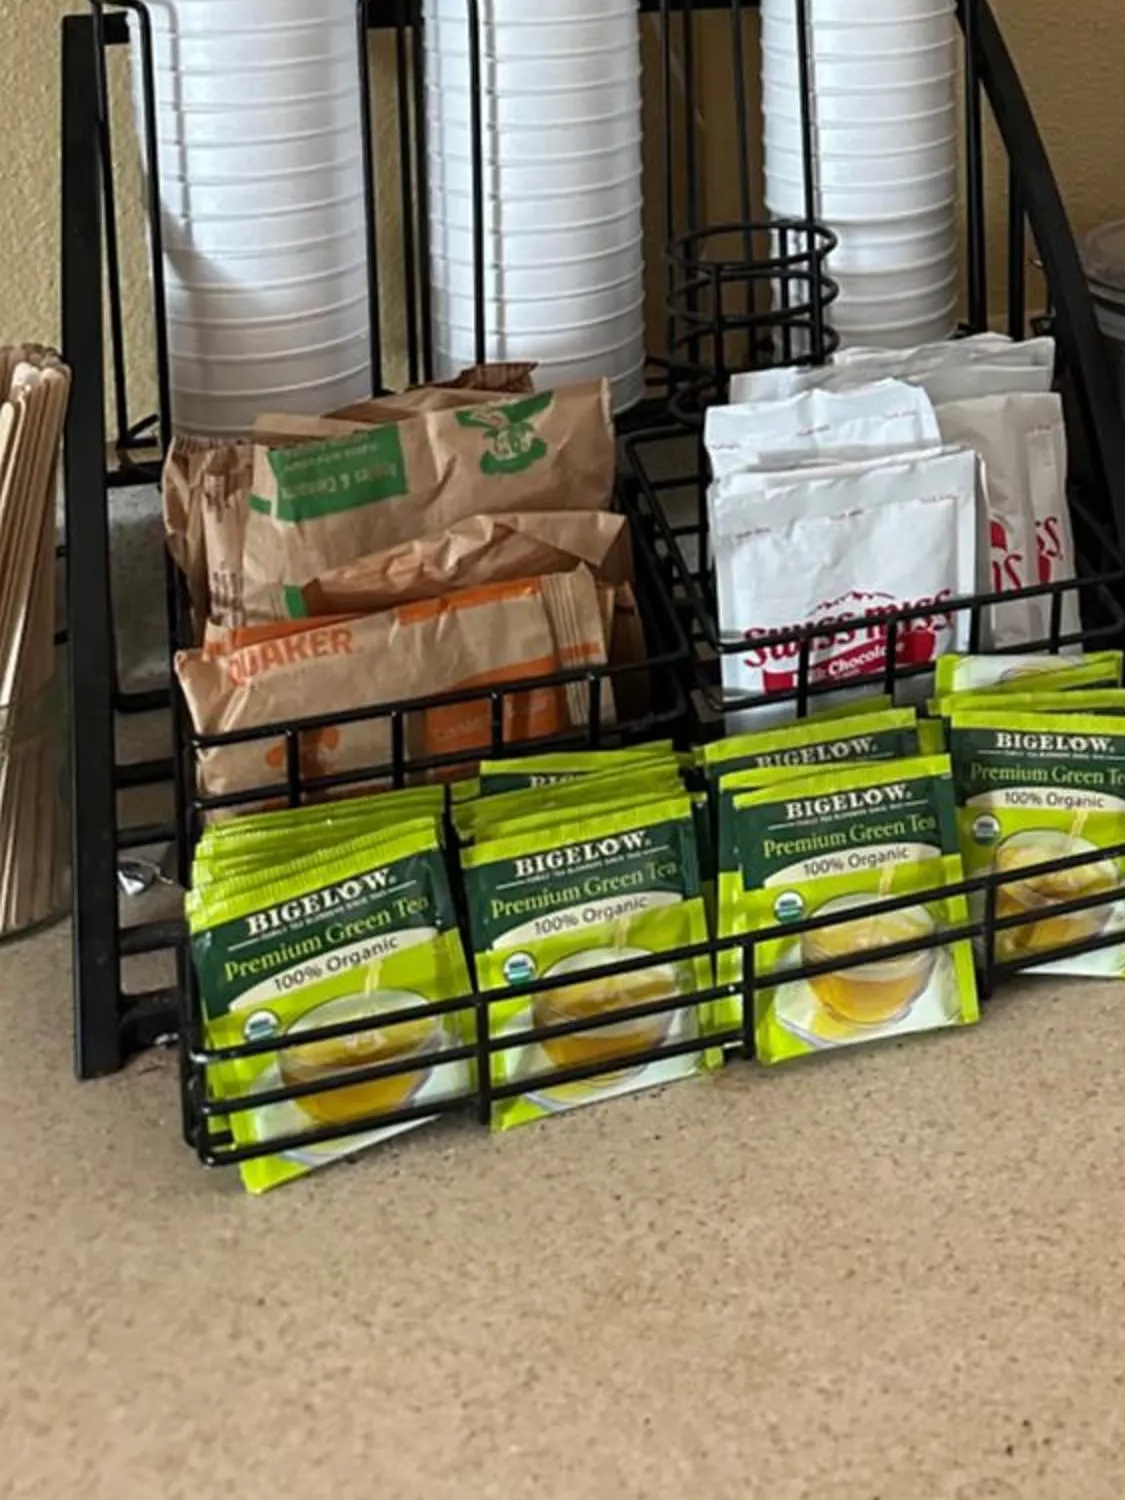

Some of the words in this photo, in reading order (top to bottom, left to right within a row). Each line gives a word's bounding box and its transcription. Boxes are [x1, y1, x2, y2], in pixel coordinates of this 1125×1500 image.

[828, 642, 905, 676] Chocole
[996, 732, 1112, 753] BIGELOW
[970, 762, 1048, 783] Premium
[1051, 764, 1104, 785] Green
[785, 784, 907, 820] BIGELOW
[1005, 791, 1042, 806] 100%
[1046, 792, 1104, 810] Organic
[514, 831, 646, 878] BIGELOW
[763, 831, 847, 859] Premium
[850, 819, 905, 841] Green
[906, 813, 937, 832] Tea
[804, 858, 844, 877] 100%
[848, 845, 911, 869] Organic
[246, 868, 392, 936] BIGELOW
[490, 886, 581, 919] Premium
[584, 869, 644, 895] Green
[645, 861, 677, 880] Tea
[534, 913, 579, 936] 100%
[582, 896, 648, 923] Organic
[224, 933, 322, 982] Premium
[325, 906, 391, 942] Green
[392, 896, 429, 918] Tea
[274, 964, 323, 992] 100%
[326, 935, 398, 972] Organic
